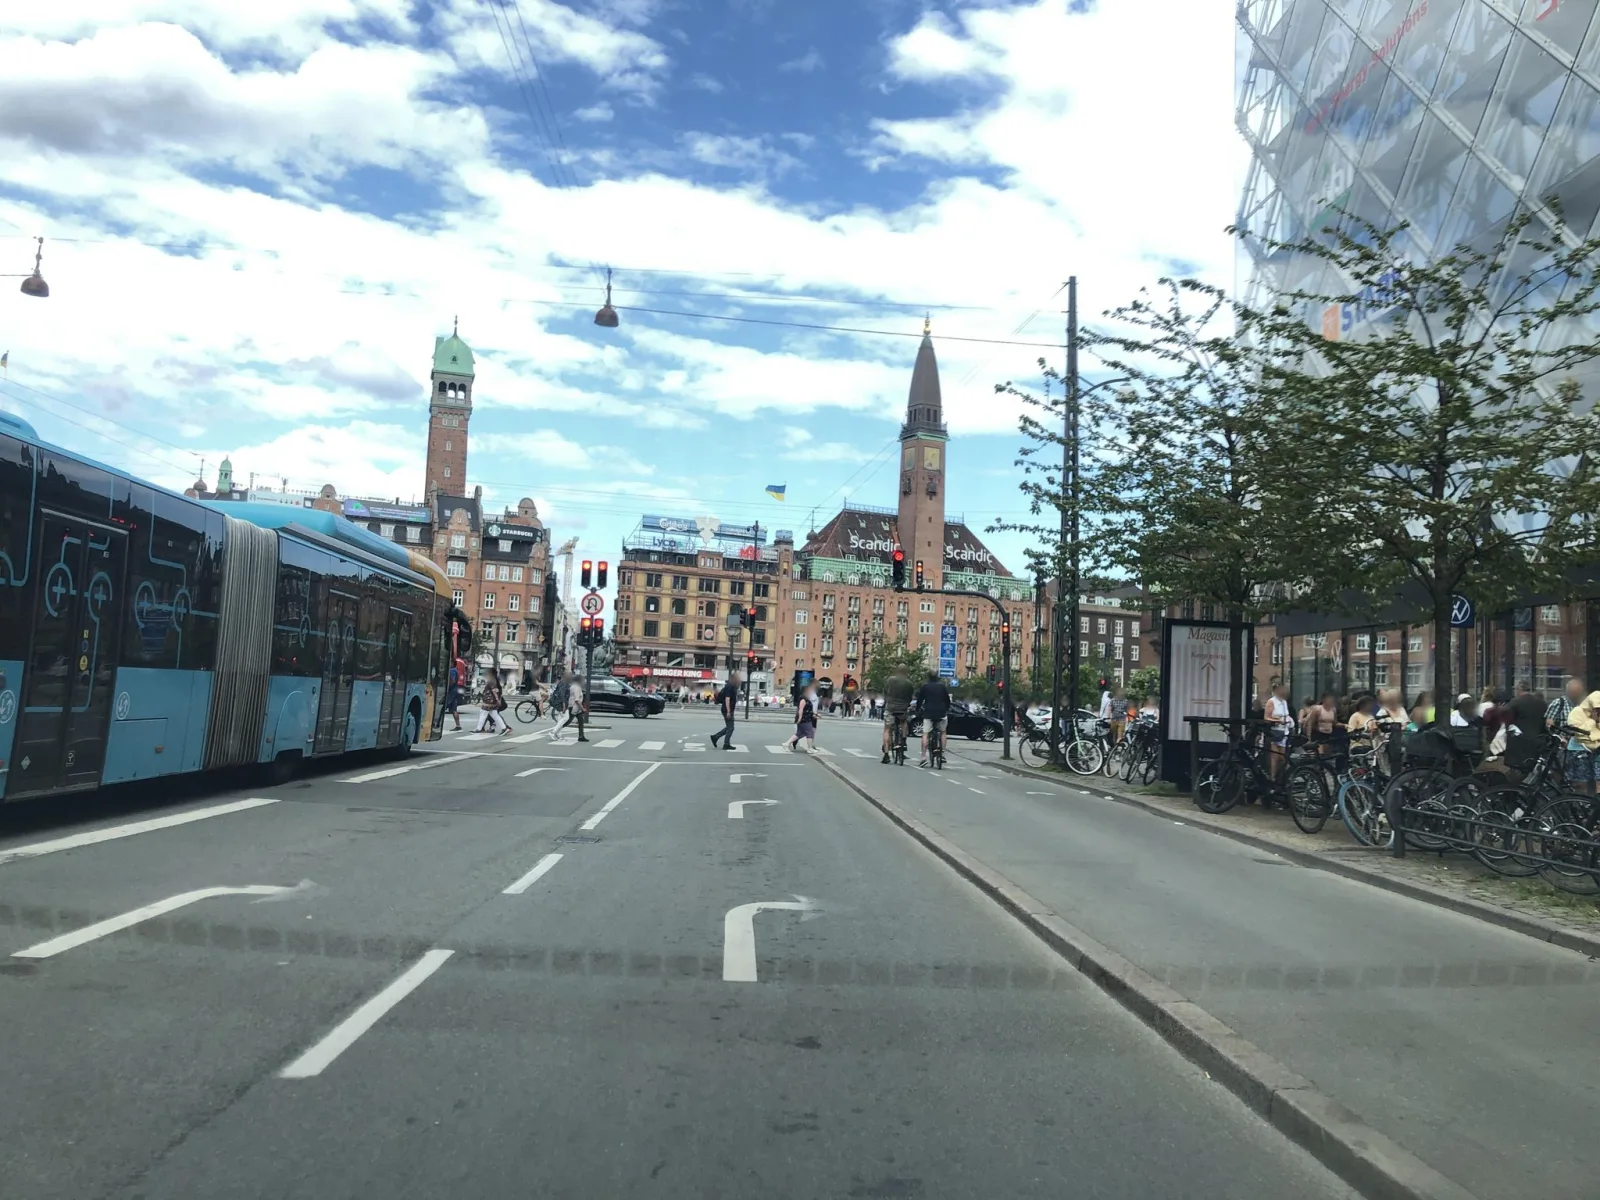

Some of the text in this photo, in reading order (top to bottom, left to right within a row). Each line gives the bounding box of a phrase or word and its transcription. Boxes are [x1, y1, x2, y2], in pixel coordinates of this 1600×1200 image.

[850, 536, 901, 552] Scandic
[946, 545, 995, 563] Scandic
[958, 574, 996, 587] HOTEL
[653, 668, 702, 678] BURGER KING
